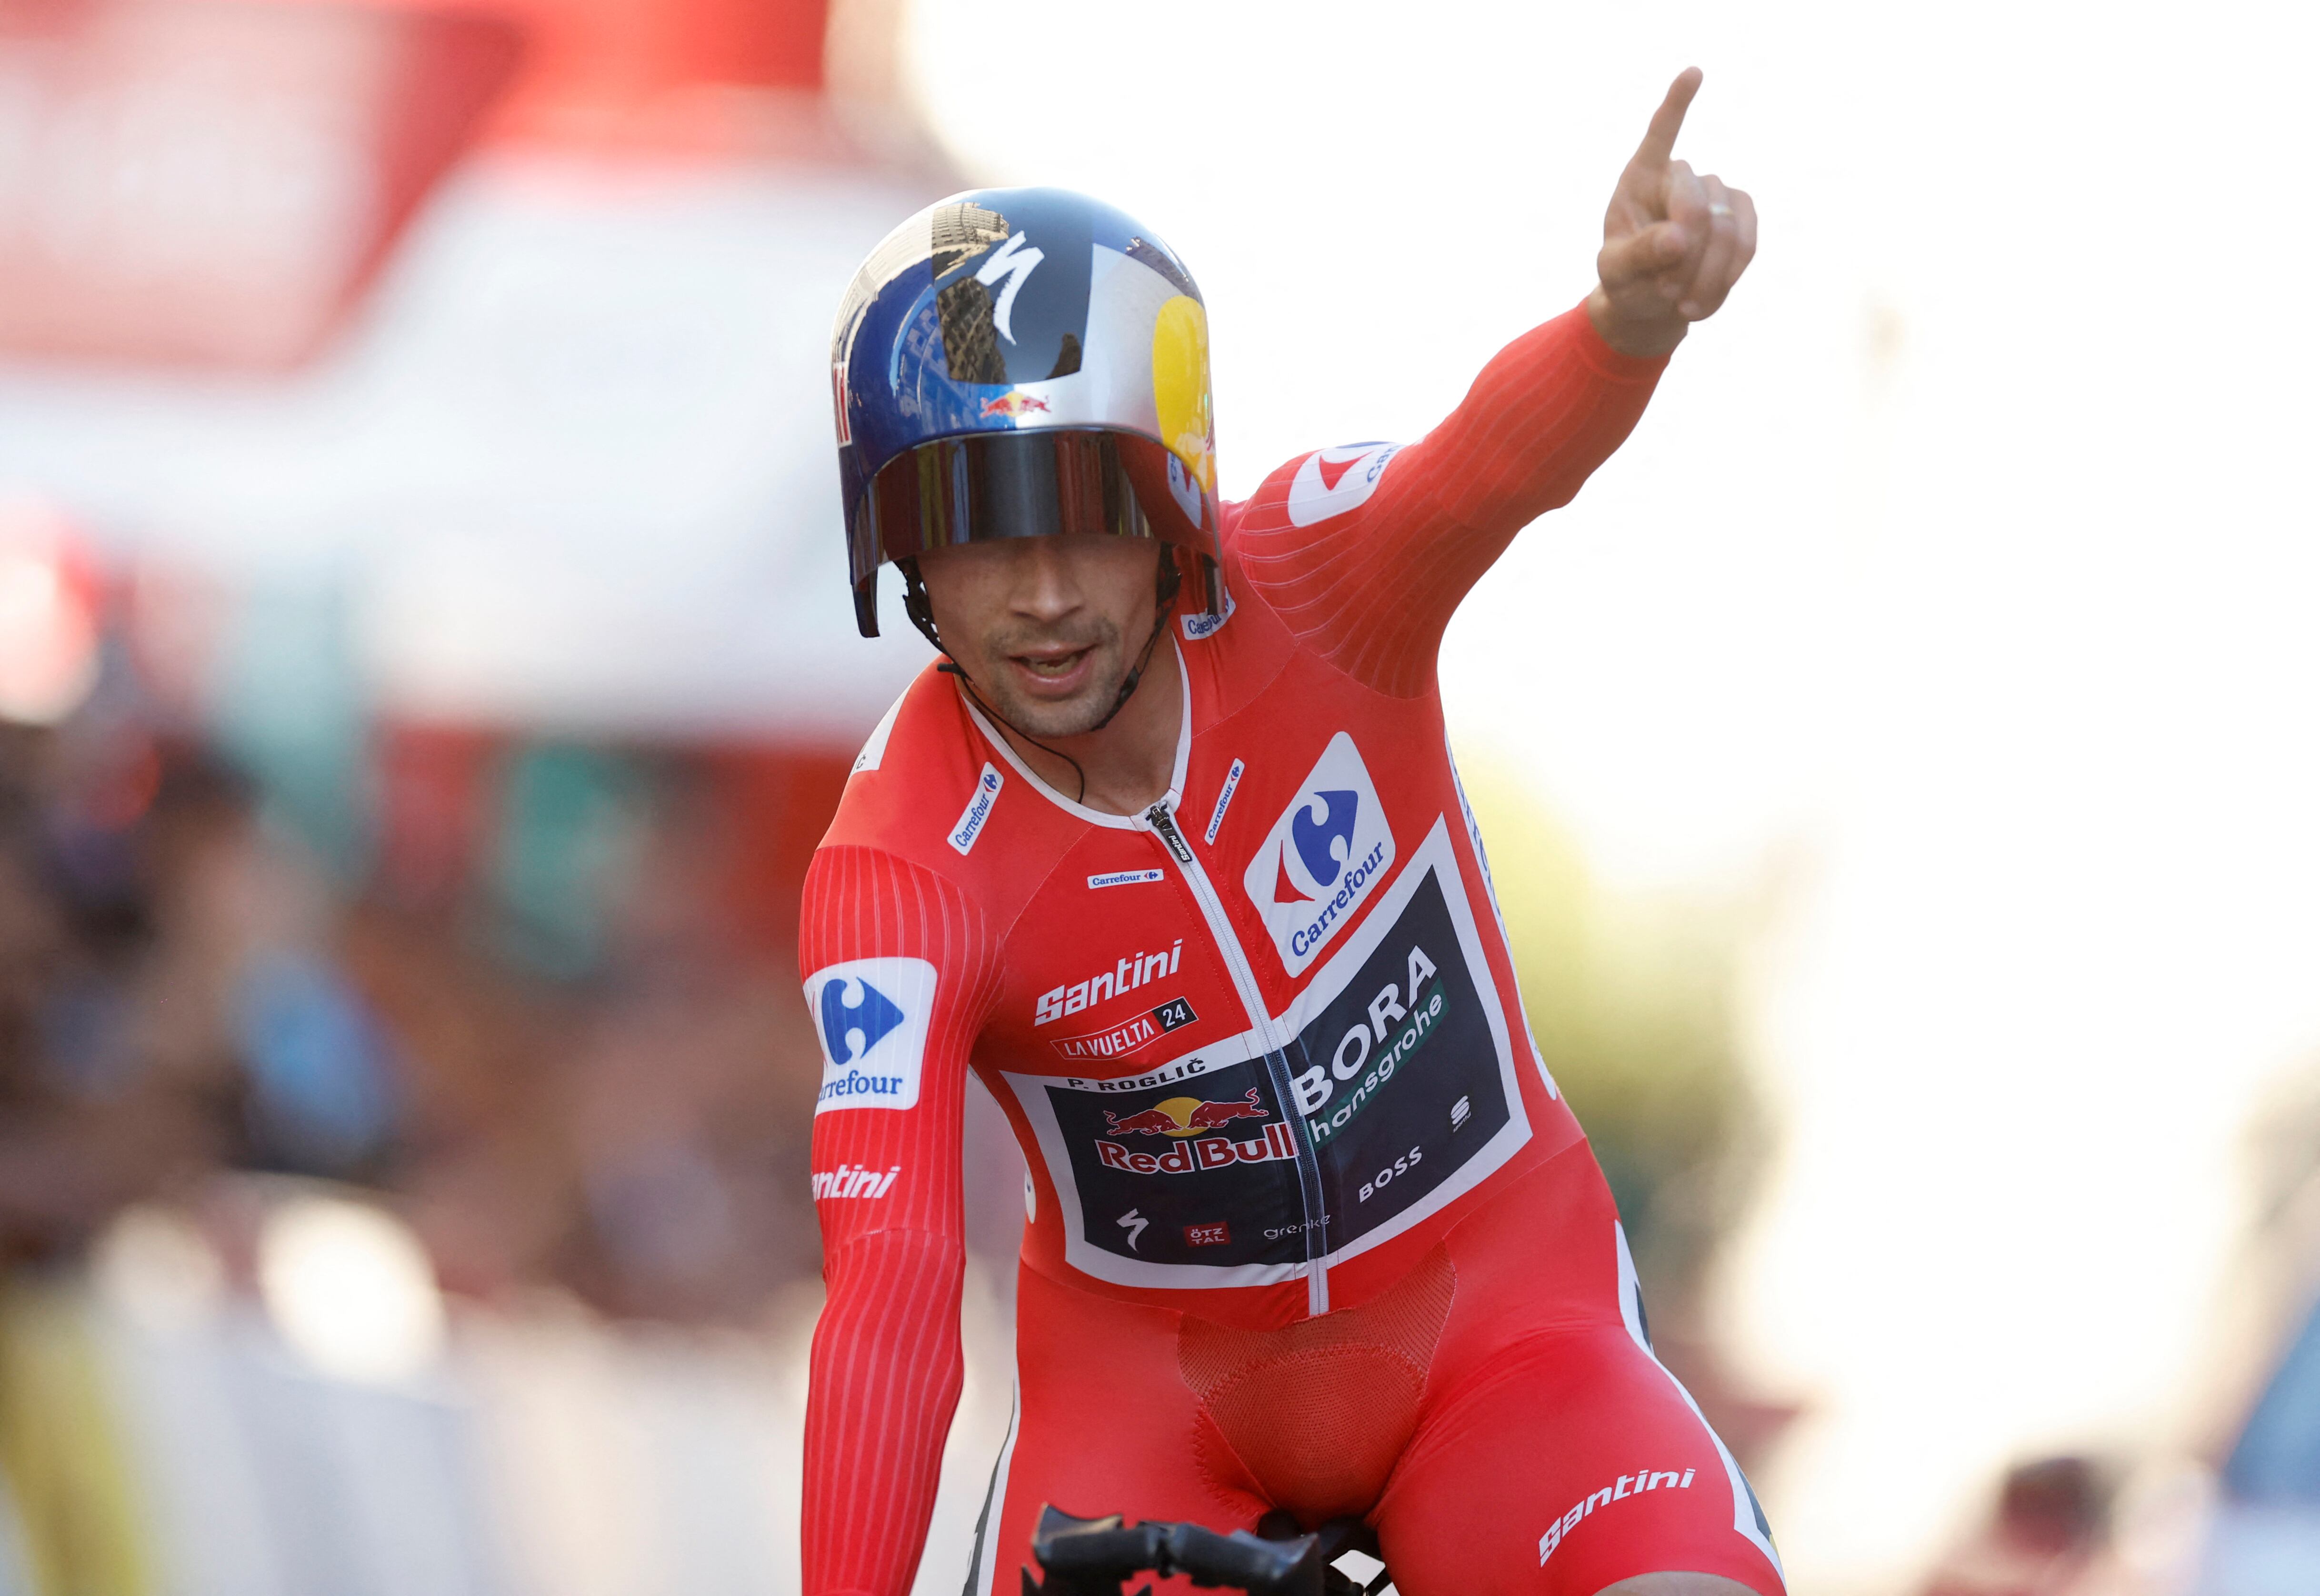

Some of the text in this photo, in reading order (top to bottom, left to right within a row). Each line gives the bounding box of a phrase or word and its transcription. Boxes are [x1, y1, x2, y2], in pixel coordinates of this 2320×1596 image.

[955, 794, 989, 848] Carrefour
[1209, 784, 1233, 839] Carrefour
[1169, 835, 1190, 861] Santini
[1093, 874, 1141, 886] Carrefour
[1292, 841, 1383, 957] Carrefour
[1034, 938, 1182, 1027] Santini
[1162, 1003, 1186, 1027] 24
[1290, 945, 1437, 1116] BORA
[819, 1070, 903, 1102] rrefour
[1068, 1058, 1206, 1091] P. ROGLIČ
[1310, 994, 1442, 1143] hansgrohe
[1095, 1122, 1300, 1174] Red Bull
[1360, 1145, 1422, 1203] BOSS
[812, 1165, 901, 1202] antini
[1190, 1228, 1223, 1238] ÖTZ
[1264, 1215, 1330, 1239] grenke
[1539, 1468, 1696, 1567] Santini
